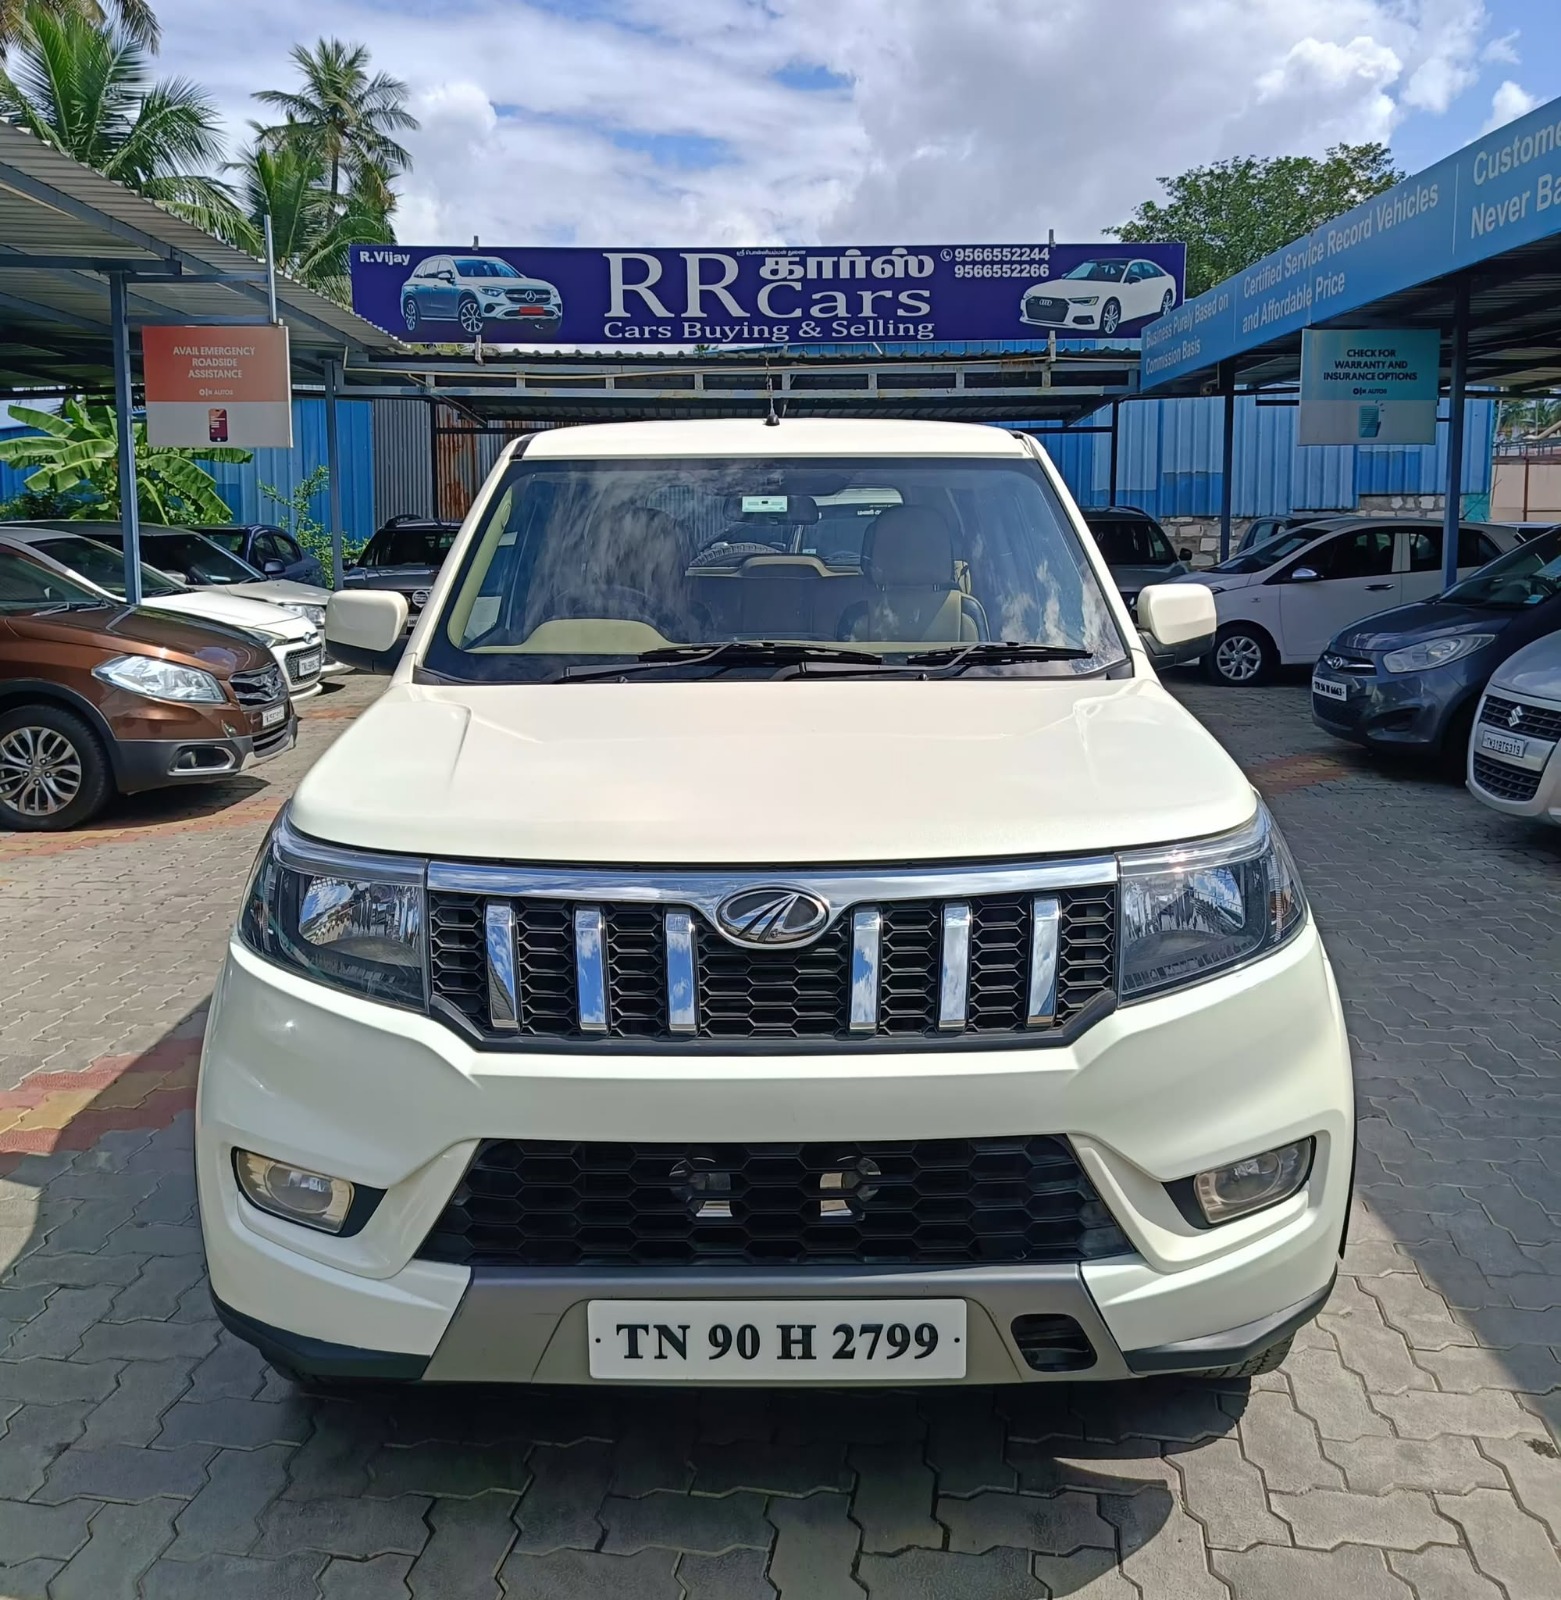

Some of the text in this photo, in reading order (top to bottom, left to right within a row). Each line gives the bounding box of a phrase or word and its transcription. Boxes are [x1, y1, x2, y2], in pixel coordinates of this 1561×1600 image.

[1470, 190, 1531, 239] Never
[1243, 183, 1439, 298] Certified Service Record Vehicles
[359, 250, 411, 266] R.Vijay
[759, 247, 935, 280] கார்ஸ்
[954, 247, 1050, 261] 9566552244
[954, 263, 1050, 278] 9566552266
[602, 252, 931, 318] RR Cars
[1242, 271, 1345, 334] and Affordable Price
[604, 319, 935, 342] Cars Buying & Selling
[1146, 293, 1229, 349] Business Purely Based on
[173, 346, 256, 356] AVAIL EMERGENCY
[1145, 335, 1200, 375] Commission Basis
[1346, 349, 1397, 358] CHECK FOR
[192, 357, 238, 367] ROADSIDE
[1334, 360, 1408, 369] WARRANTY AND
[188, 369, 243, 378] ASSISTANCE
[1323, 372, 1418, 381] INSURANCE OPTIONS
[615, 1322, 940, 1361] TN 90 H 2799
